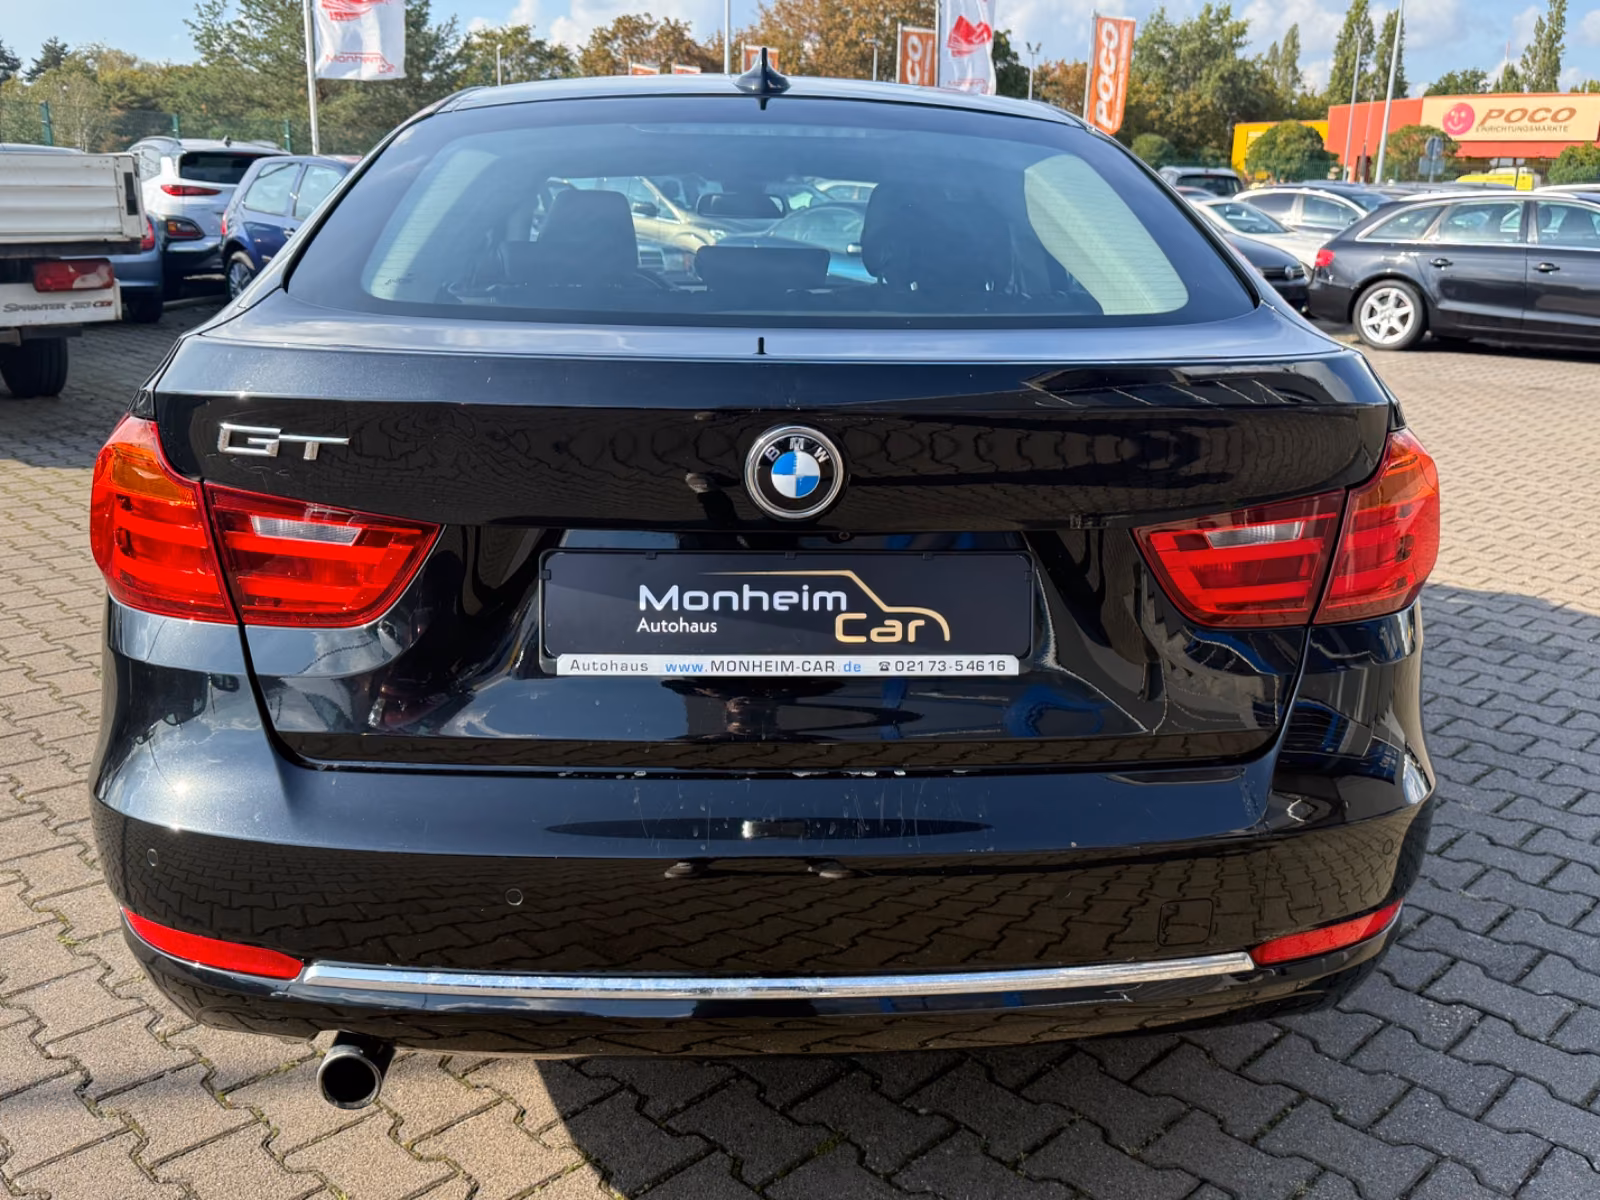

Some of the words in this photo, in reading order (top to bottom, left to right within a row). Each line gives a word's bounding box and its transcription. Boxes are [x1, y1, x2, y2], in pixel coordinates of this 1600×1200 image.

[1096, 20, 1119, 131] POCO
[1478, 107, 1577, 127] POCO
[217, 422, 350, 460] GT
[765, 437, 830, 463] BMW
[639, 584, 847, 612] Monheim
[636, 616, 718, 633] Autohaus
[835, 612, 926, 643] Car
[569, 659, 649, 672] Autohaus
